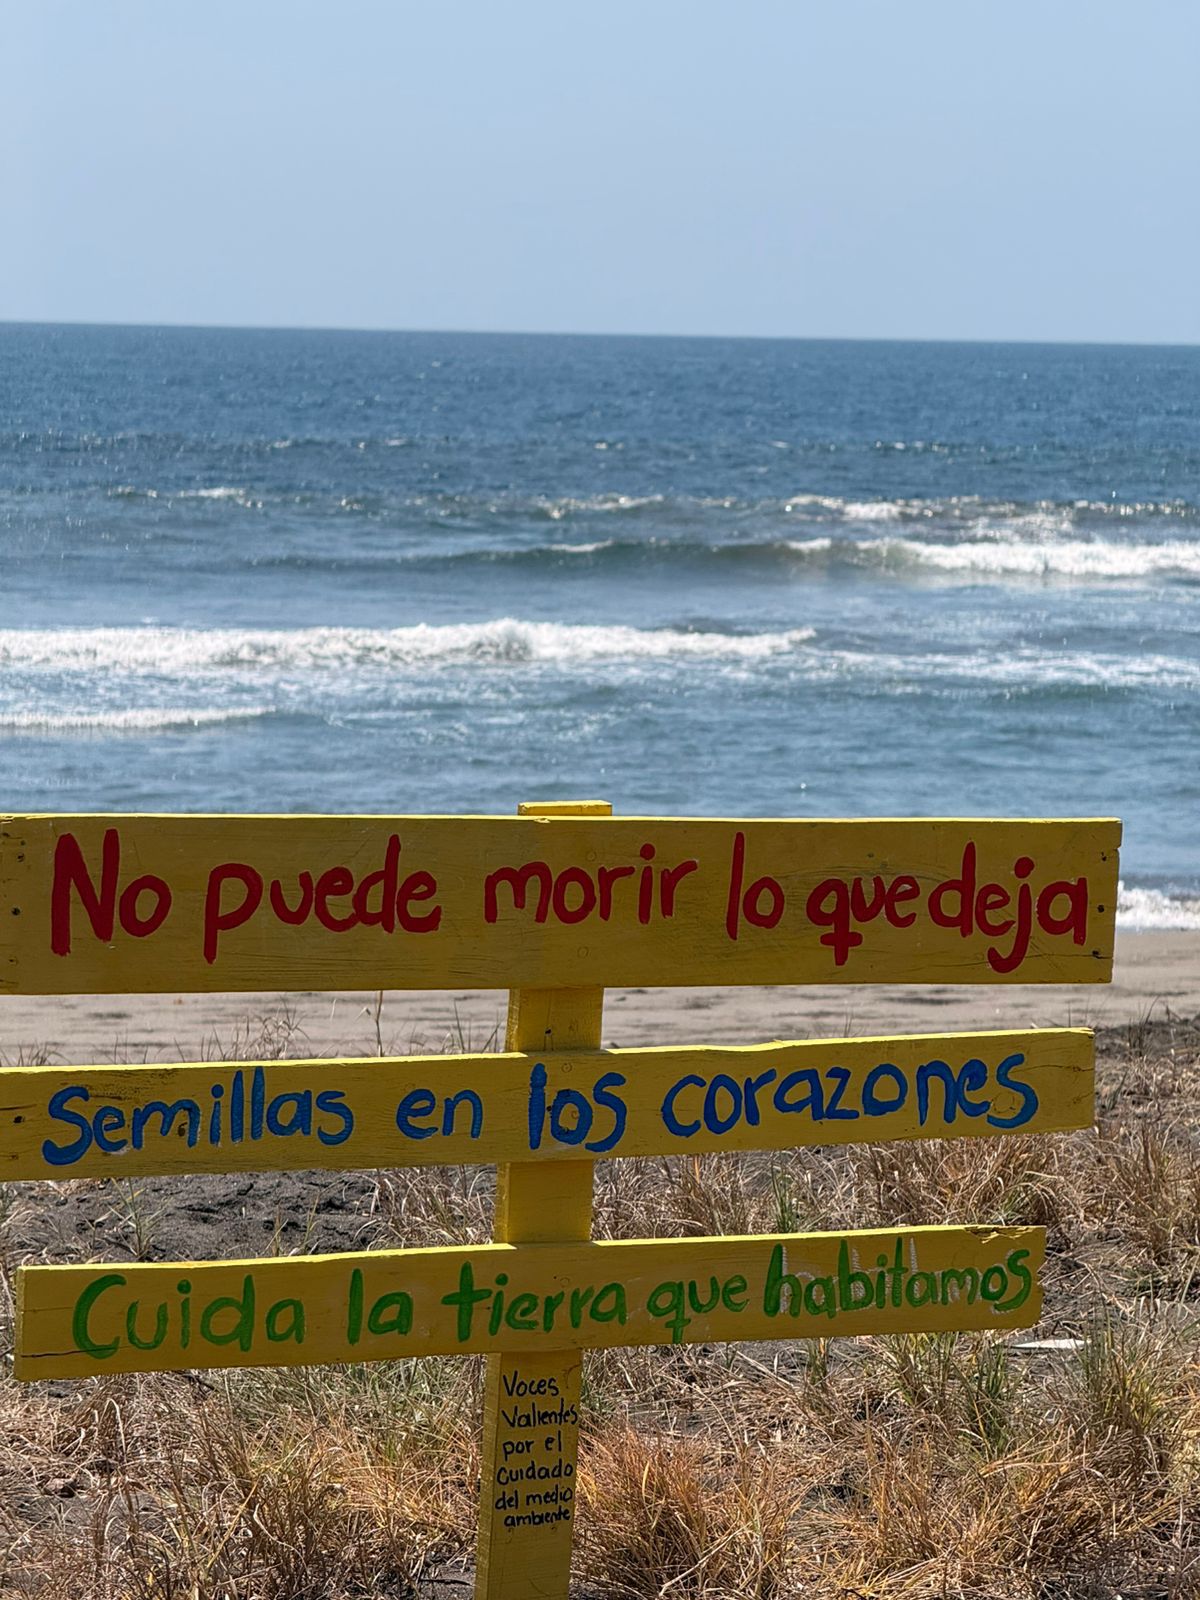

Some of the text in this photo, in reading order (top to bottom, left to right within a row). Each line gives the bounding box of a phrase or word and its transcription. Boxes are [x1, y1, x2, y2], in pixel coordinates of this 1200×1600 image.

[51, 828, 1088, 974] No puede morir lo que deja
[42, 1053, 1039, 1165] Semillas en los corazones
[72, 1236, 1032, 1359] Cuida la tierra que habitamos
[503, 1371, 560, 1397] Voces
[502, 1398, 578, 1428] Valientes
[503, 1430, 562, 1461] por el
[495, 1484, 573, 1511] del medio
[504, 1505, 571, 1528] ambiente
